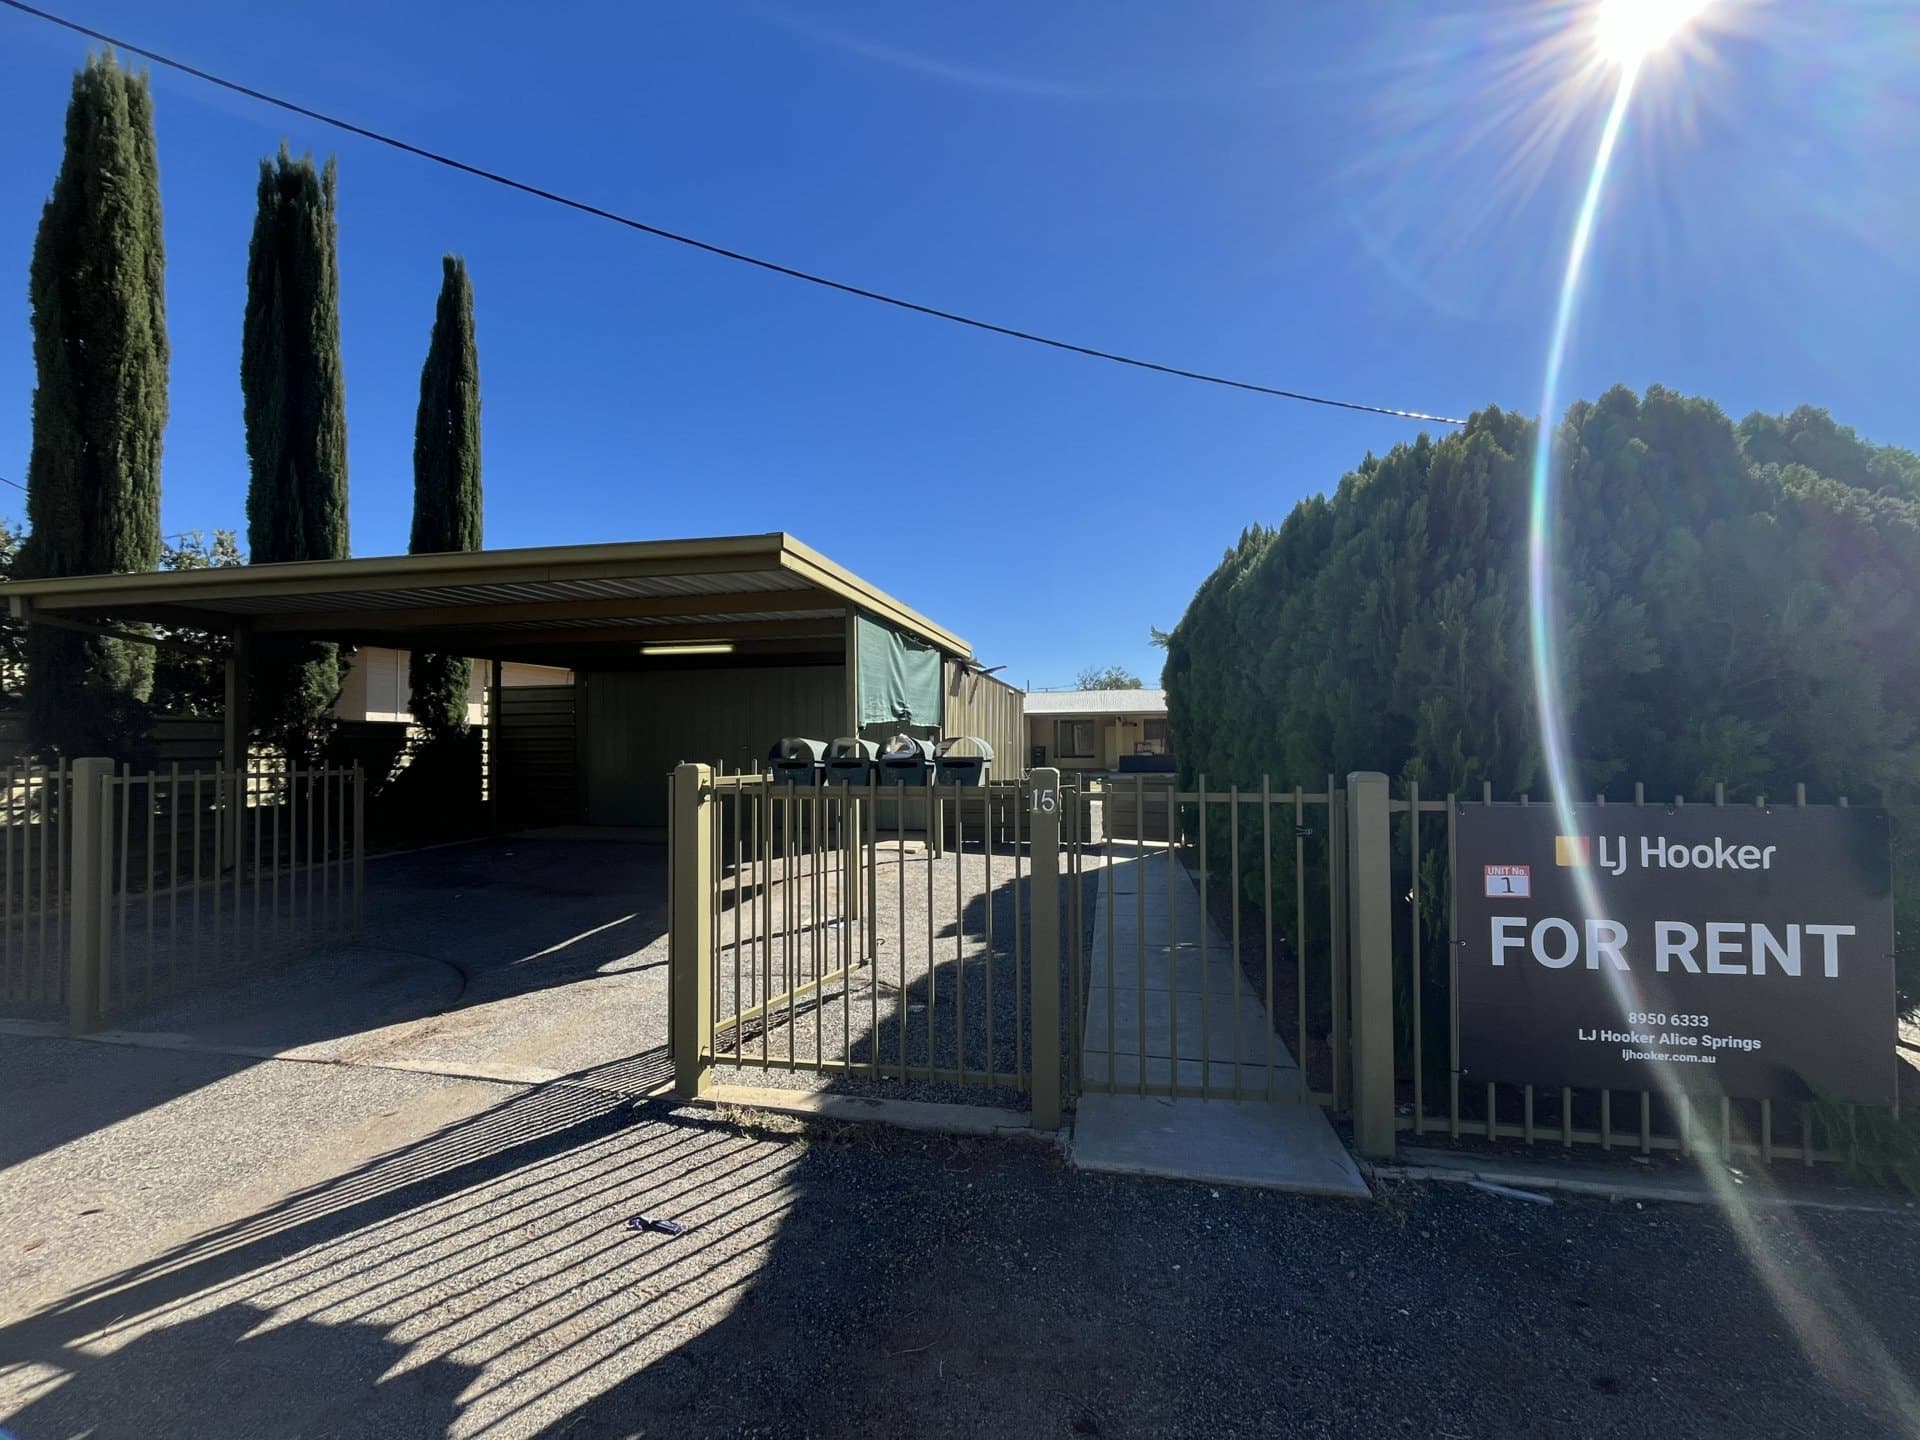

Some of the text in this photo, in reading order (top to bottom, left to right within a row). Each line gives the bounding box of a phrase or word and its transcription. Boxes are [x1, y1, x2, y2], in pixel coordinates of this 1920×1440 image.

[1032, 789, 1056, 812] 15
[1599, 835, 1777, 876] LJ Hooker
[1487, 866, 1510, 876] UNIT
[1501, 877, 1515, 894] 1
[1490, 916, 1856, 978] FOR RENT
[1628, 1012, 1709, 1027] 8950 6333
[1578, 1028, 1762, 1051] LJ Hooker Alice Springs
[1622, 1049, 1716, 1063] ljhooker.com.au
